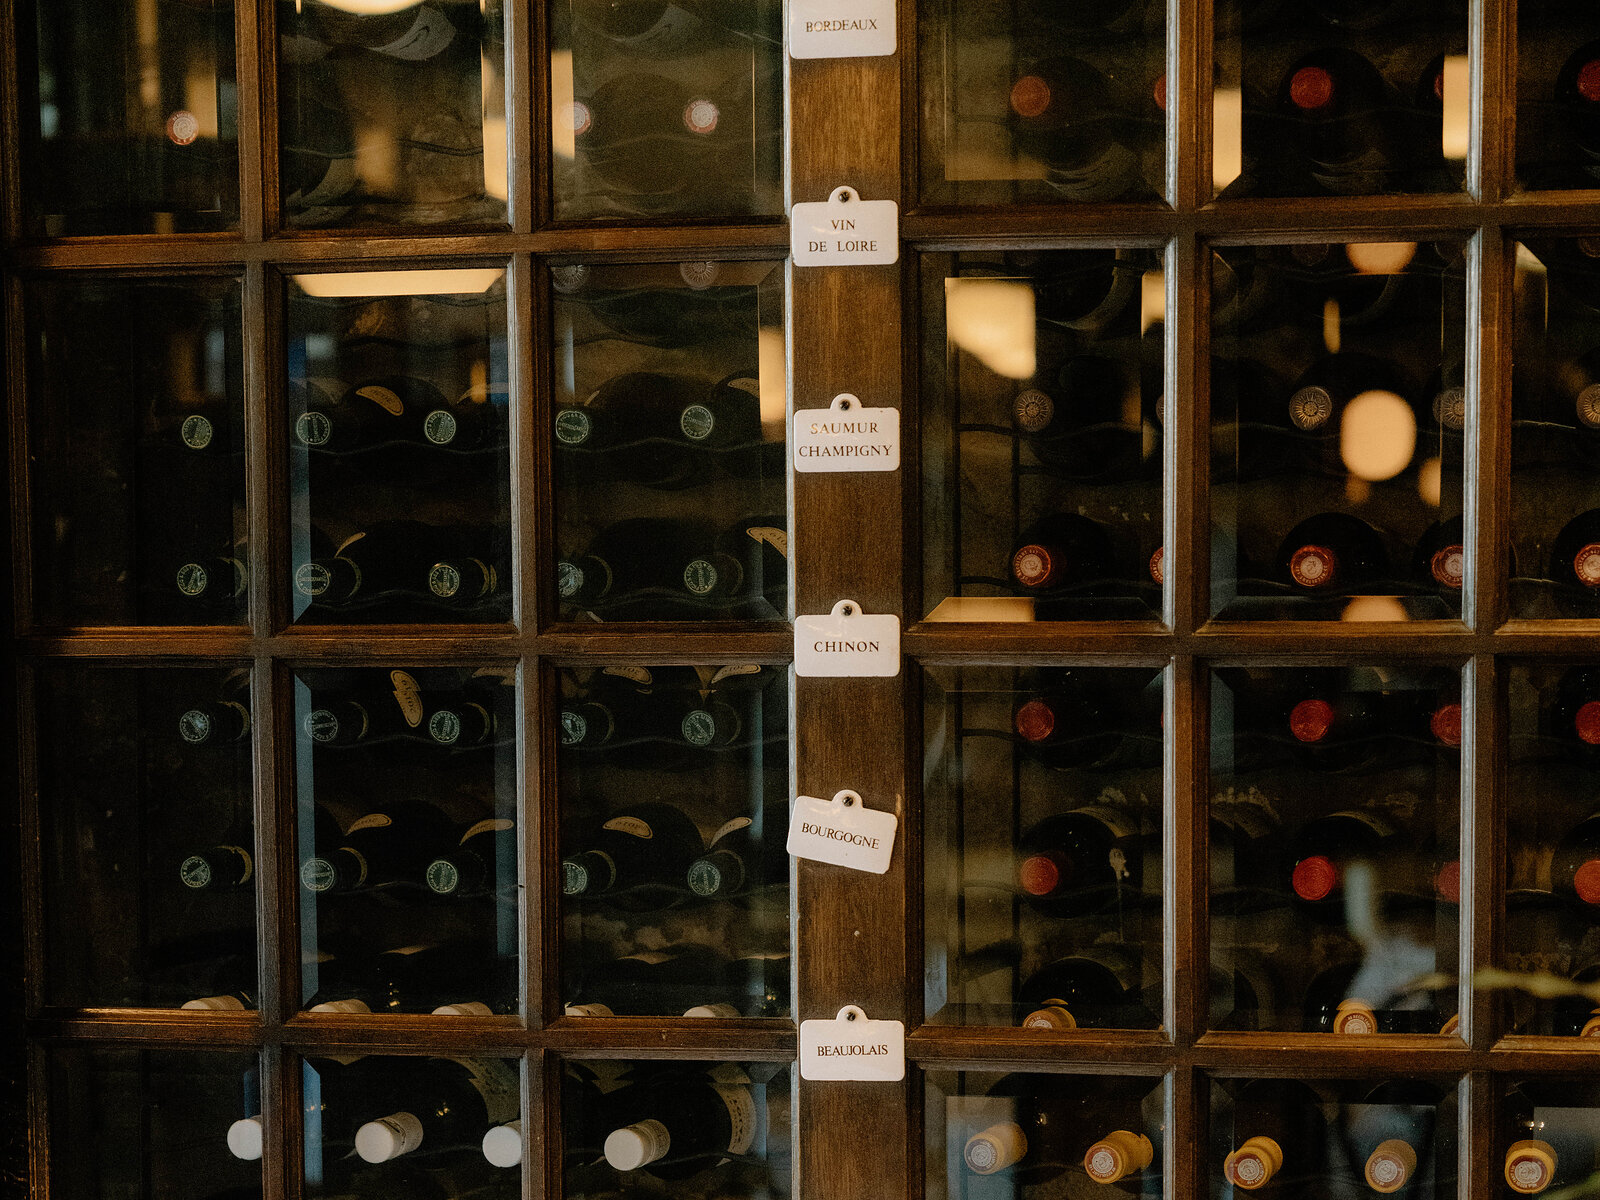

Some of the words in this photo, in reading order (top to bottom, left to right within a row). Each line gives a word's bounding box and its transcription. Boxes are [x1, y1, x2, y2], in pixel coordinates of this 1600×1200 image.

[805, 18, 878, 33] BORDEAUX
[830, 218, 856, 231] VIN
[808, 240, 828, 253] DE
[837, 240, 878, 253] LOIRE
[810, 422, 879, 435] SAUMUR
[798, 444, 894, 458] CHAMPIGNY
[813, 640, 880, 653] CHINON
[801, 822, 881, 850] BOURGOGNE
[817, 1043, 889, 1057] BEAUJOLAIS
